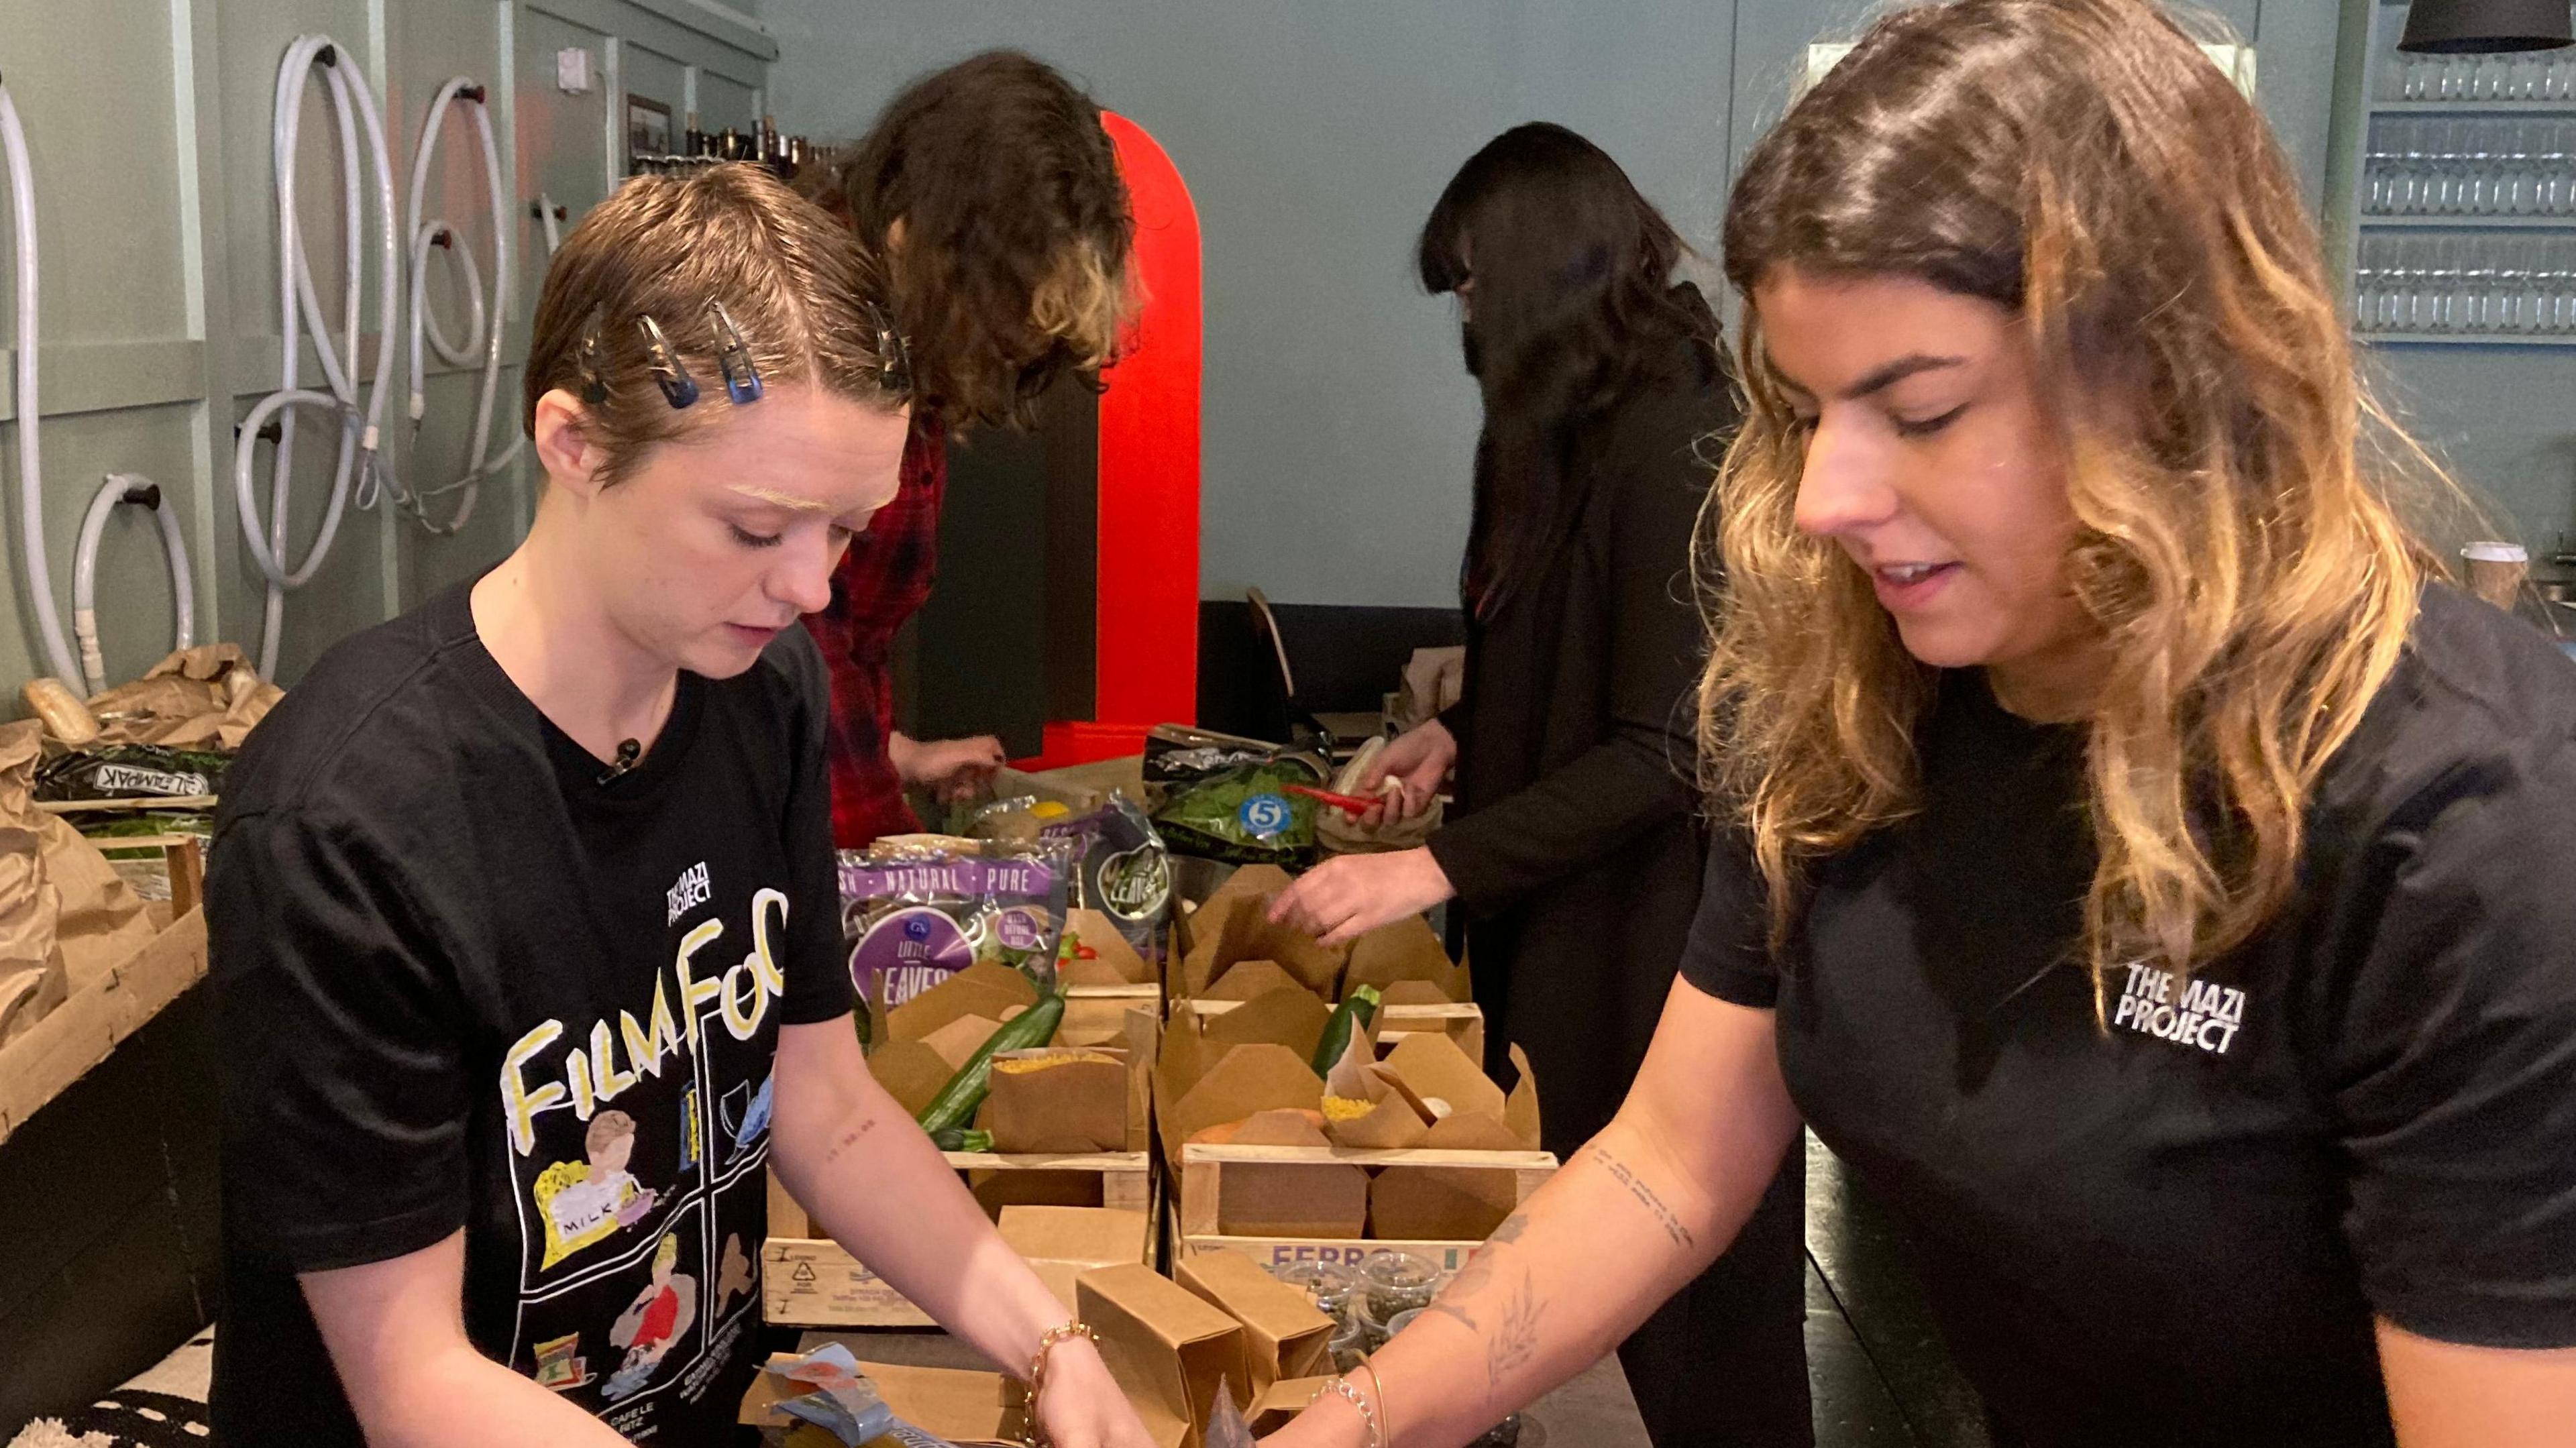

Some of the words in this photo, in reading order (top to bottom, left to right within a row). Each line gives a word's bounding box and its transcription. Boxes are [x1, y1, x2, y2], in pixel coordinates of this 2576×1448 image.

[1254, 803, 1276, 826] 5
[678, 861, 708, 895] MAZI
[885, 868, 959, 892] NATURAL
[987, 868, 1030, 892] PURE
[668, 879, 711, 928] PROJECT
[2126, 962, 2174, 1003] THE
[2180, 979, 2246, 1023] MAZI
[2114, 994, 2240, 1054] PROJECT
[564, 1203, 612, 1234] MILK
